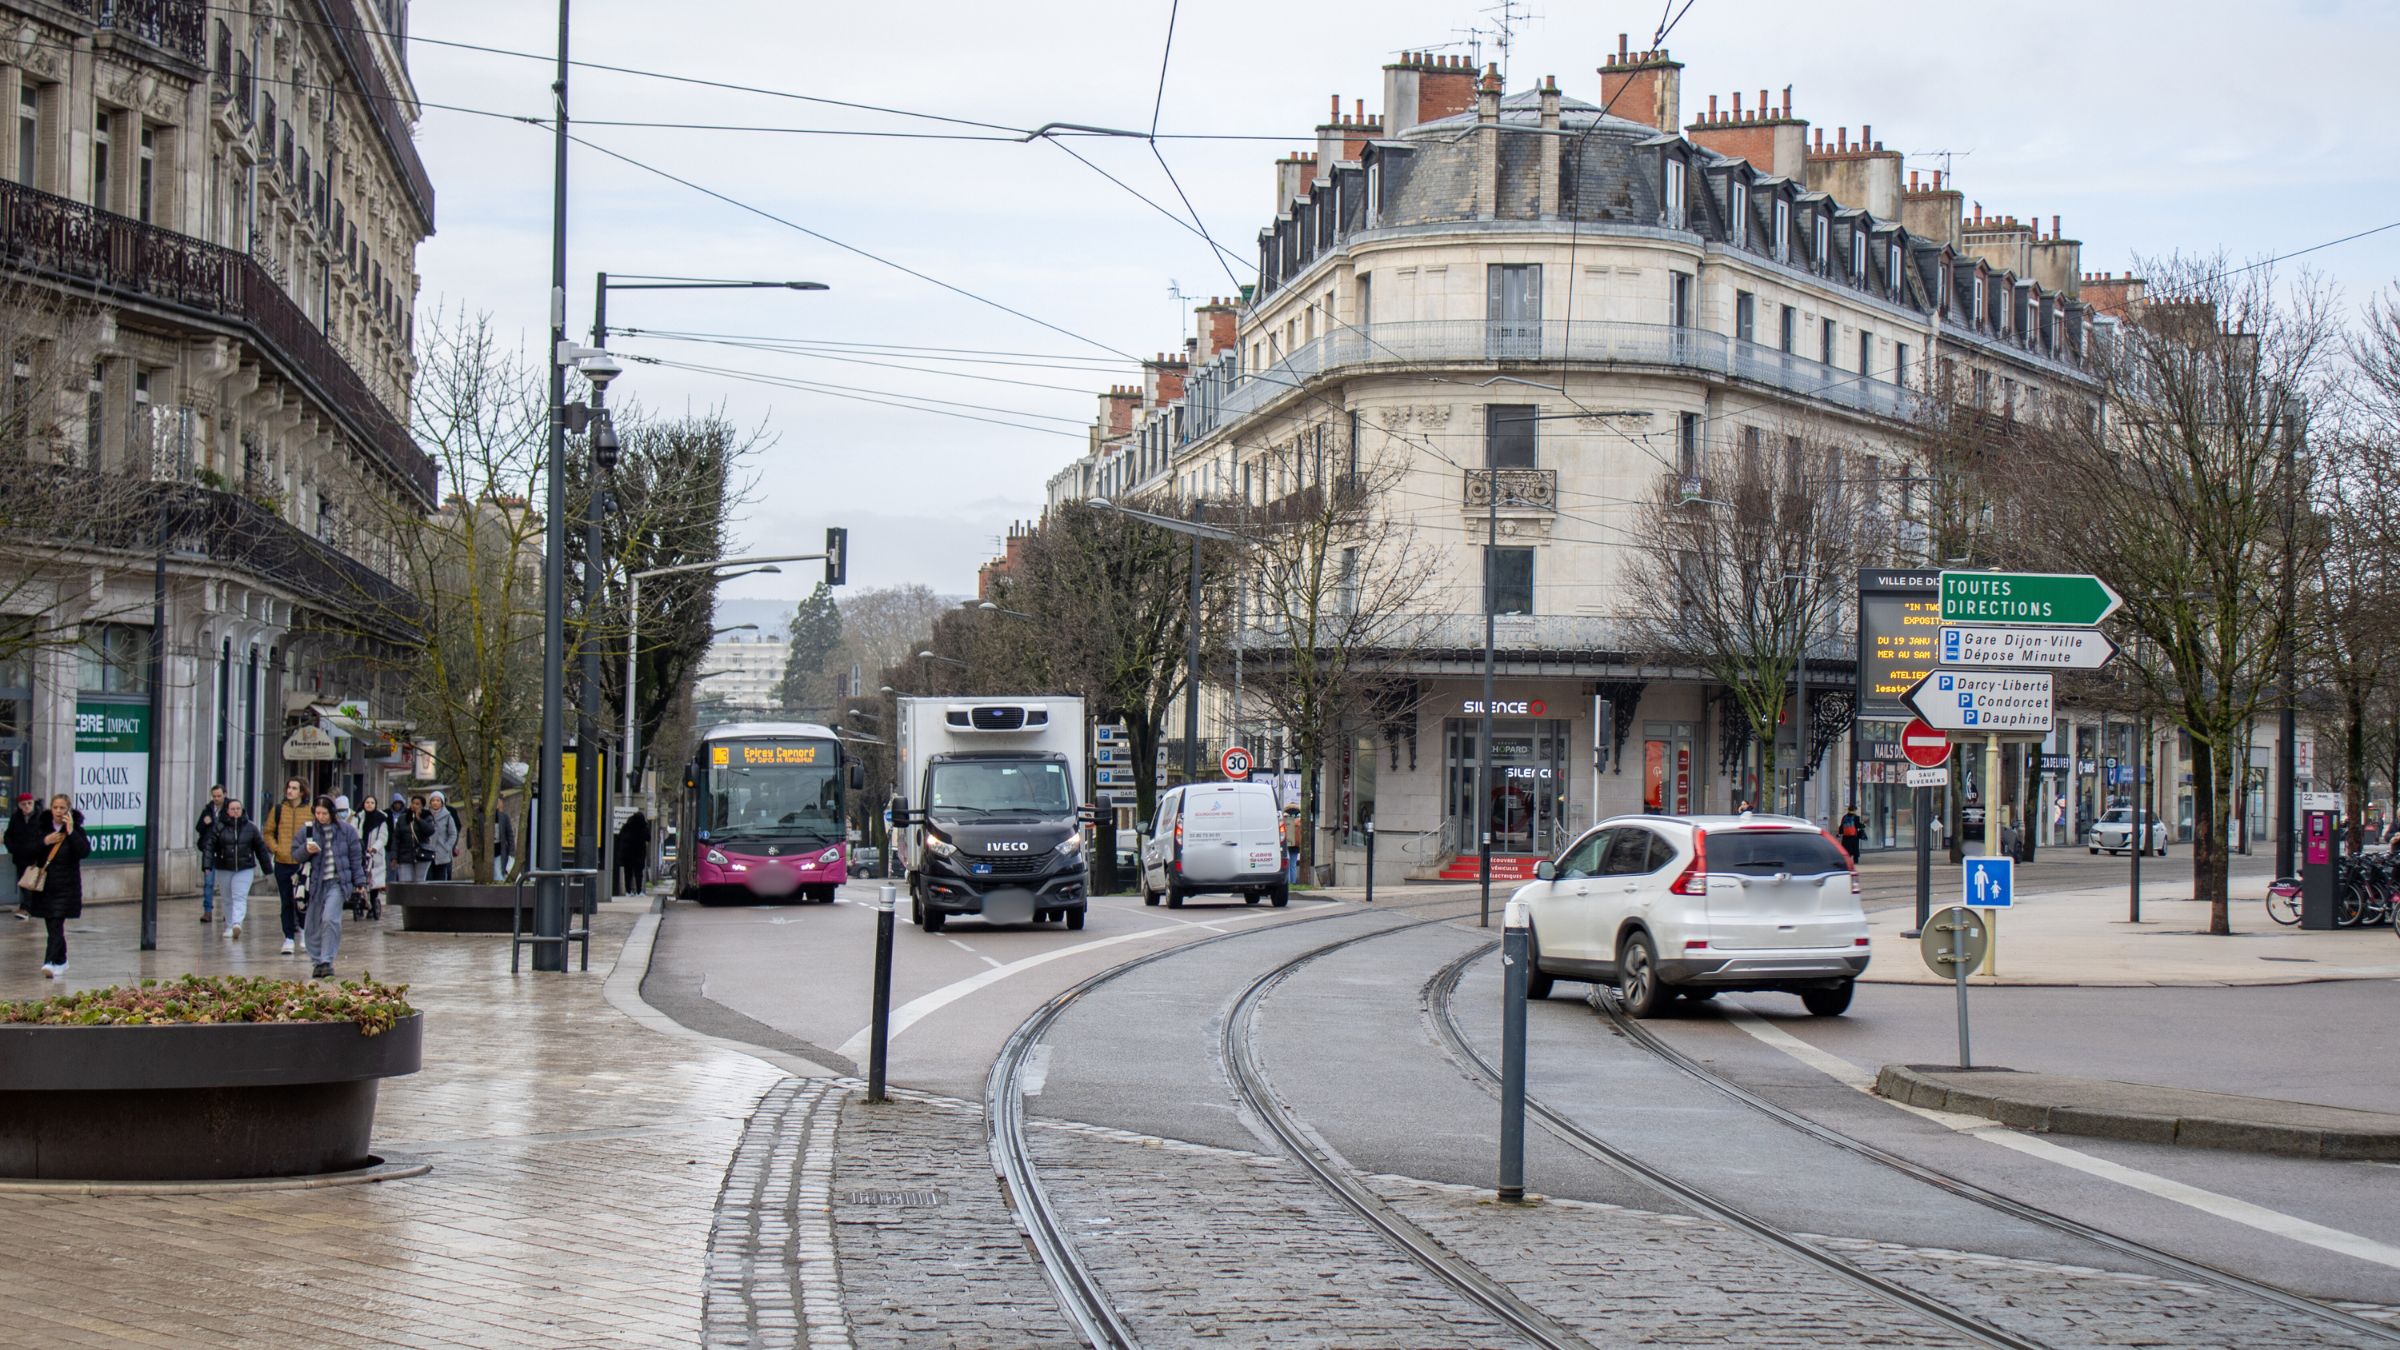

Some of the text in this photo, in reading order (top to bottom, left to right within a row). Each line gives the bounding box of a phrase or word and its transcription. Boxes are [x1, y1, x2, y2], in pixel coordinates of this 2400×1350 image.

[1878, 577, 1905, 586] VILLE
[1909, 577, 1923, 586] DE
[1947, 580, 2011, 596] TOUTES
[1947, 600, 2052, 617] DIRECTIONS
[1877, 636, 1889, 645] DU
[1894, 636, 1905, 645] 19
[1909, 636, 1931, 646] JANV
[1964, 633, 1997, 645] Gare
[2005, 634, 2082, 648] Dijon-Ville
[1877, 650, 1894, 659] MER
[1898, 650, 1910, 659] AU
[1913, 650, 1930, 659] SAM
[1964, 649, 2014, 662] Dépose
[2022, 650, 2071, 662] Minute
[1958, 678, 2049, 692] Darcy-Liberté
[1463, 701, 1528, 714] SILENCE
[1977, 695, 2049, 708] Condorcet
[107, 718, 140, 734] IMPACT
[1982, 712, 2049, 726] Dauphine
[1875, 744, 1894, 759] NAILS
[1228, 756, 1247, 770] 30
[80, 767, 129, 785] LOCAUX
[2303, 793, 2313, 801] 22
[100, 834, 111, 851] 51
[113, 834, 124, 851] 71
[126, 833, 137, 850] 71
[987, 842, 1029, 852] IVECO
